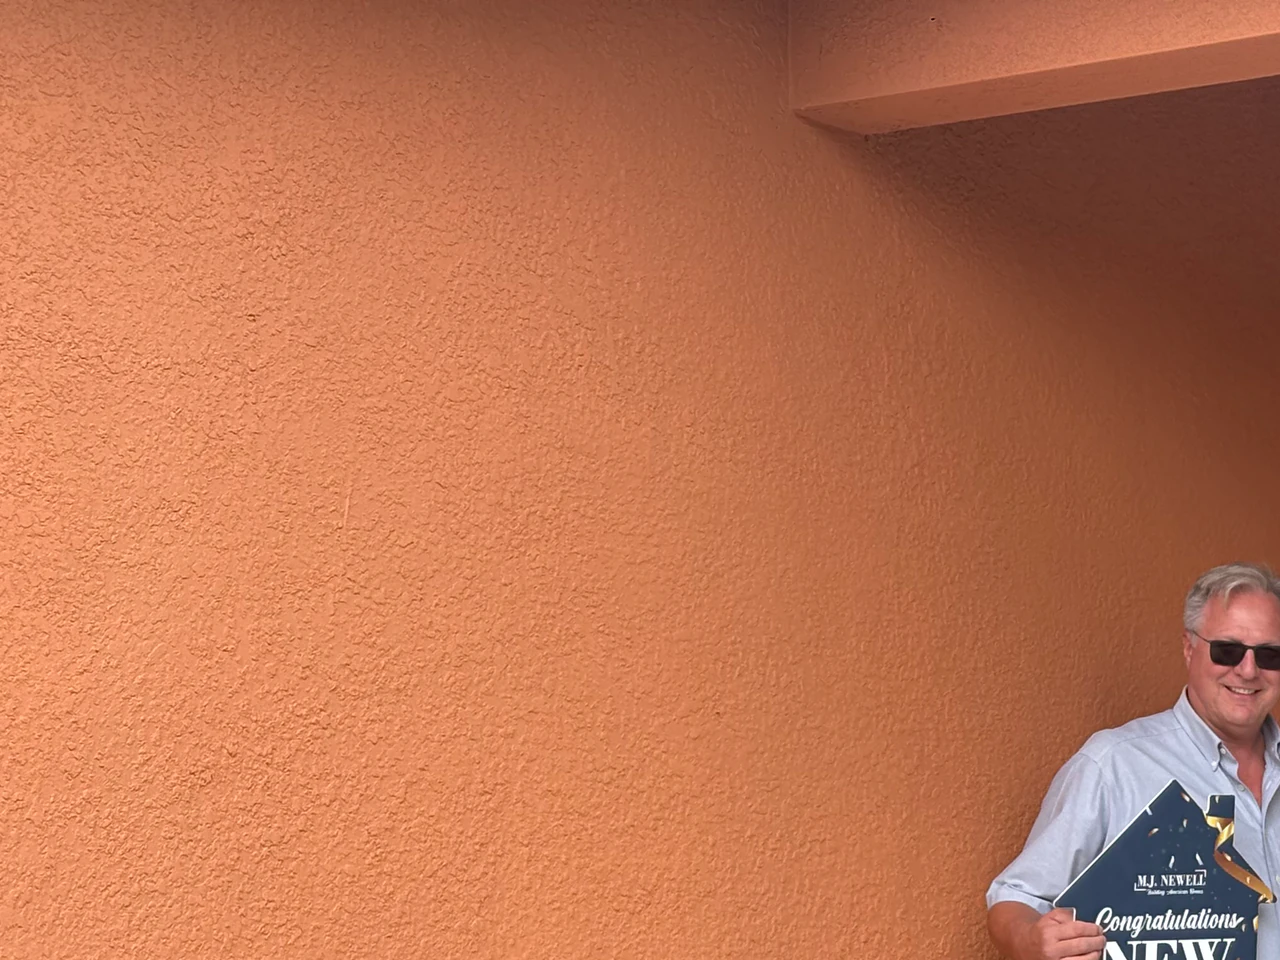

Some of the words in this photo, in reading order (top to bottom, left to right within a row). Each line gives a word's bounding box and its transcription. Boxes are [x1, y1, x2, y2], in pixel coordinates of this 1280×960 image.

[1137, 875, 1157, 888] M.J.
[1160, 874, 1206, 887] NEWELL
[1095, 907, 1244, 938] Congratulations
